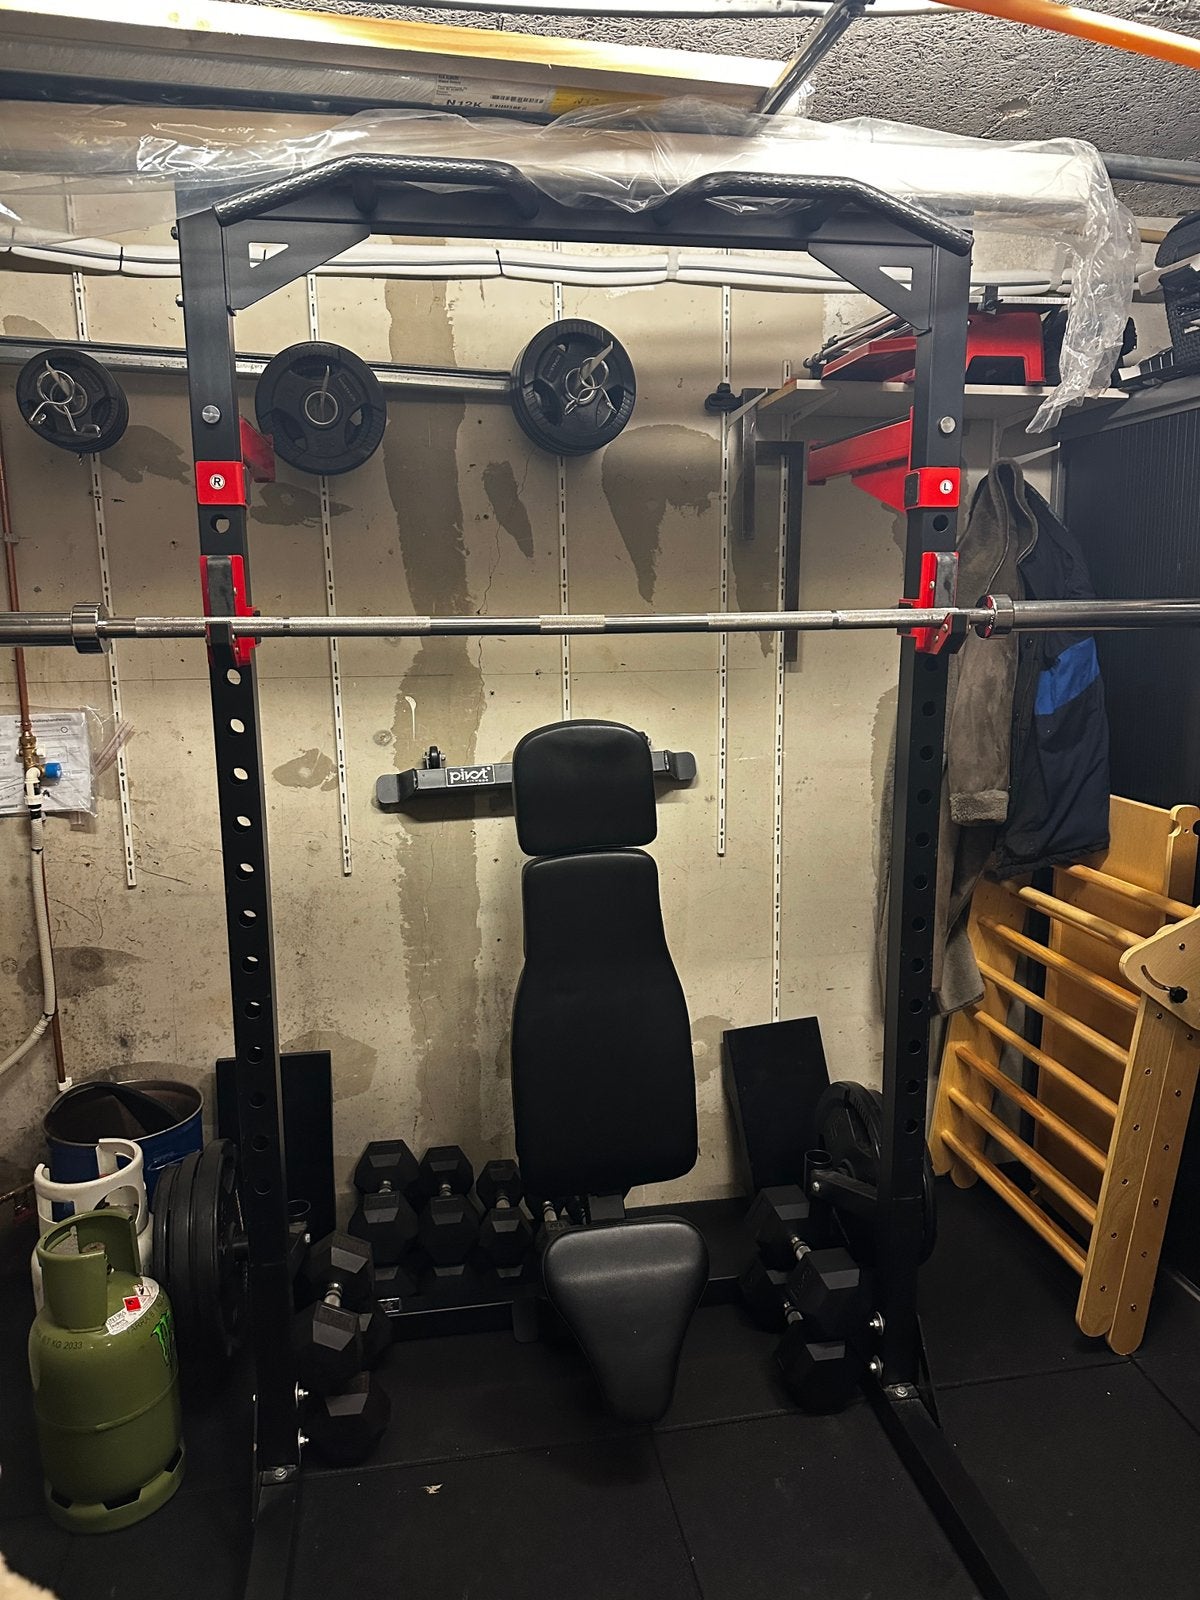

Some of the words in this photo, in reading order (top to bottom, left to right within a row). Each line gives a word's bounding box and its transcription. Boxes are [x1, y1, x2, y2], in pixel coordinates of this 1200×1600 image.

[213, 476, 222, 487] R
[450, 768, 488, 784] pivot
[63, 1341, 83, 1350] 2033
